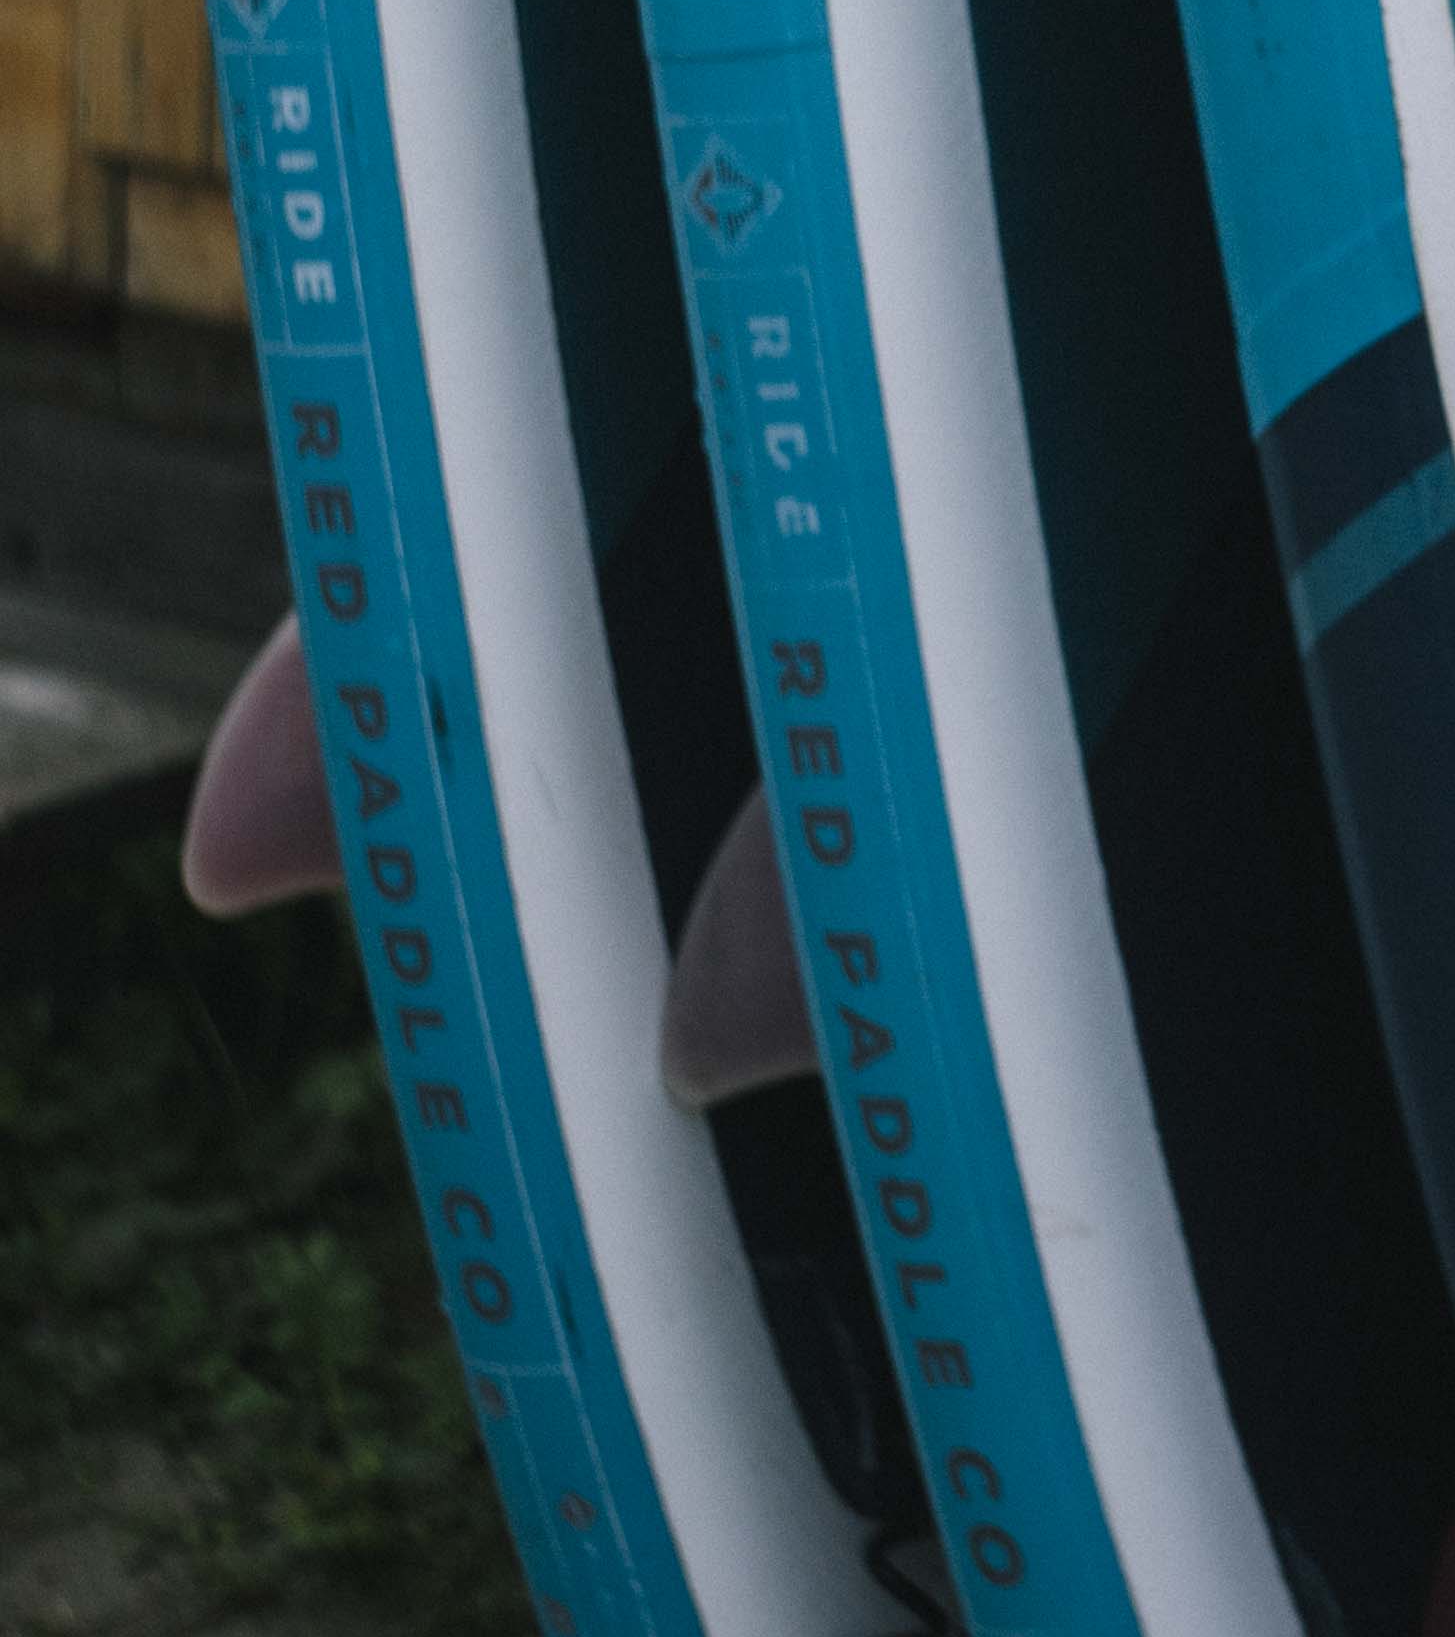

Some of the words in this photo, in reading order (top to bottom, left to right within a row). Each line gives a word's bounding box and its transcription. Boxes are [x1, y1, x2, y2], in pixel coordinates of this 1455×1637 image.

[270, 84, 337, 307] RIDE
[291, 400, 370, 625] RED
[337, 683, 469, 1133] PADDLE
[441, 1186, 514, 1324] CO
[770, 639, 856, 868] RED
[824, 930, 974, 1391] PADDLE
[944, 1445, 1024, 1588] CO
